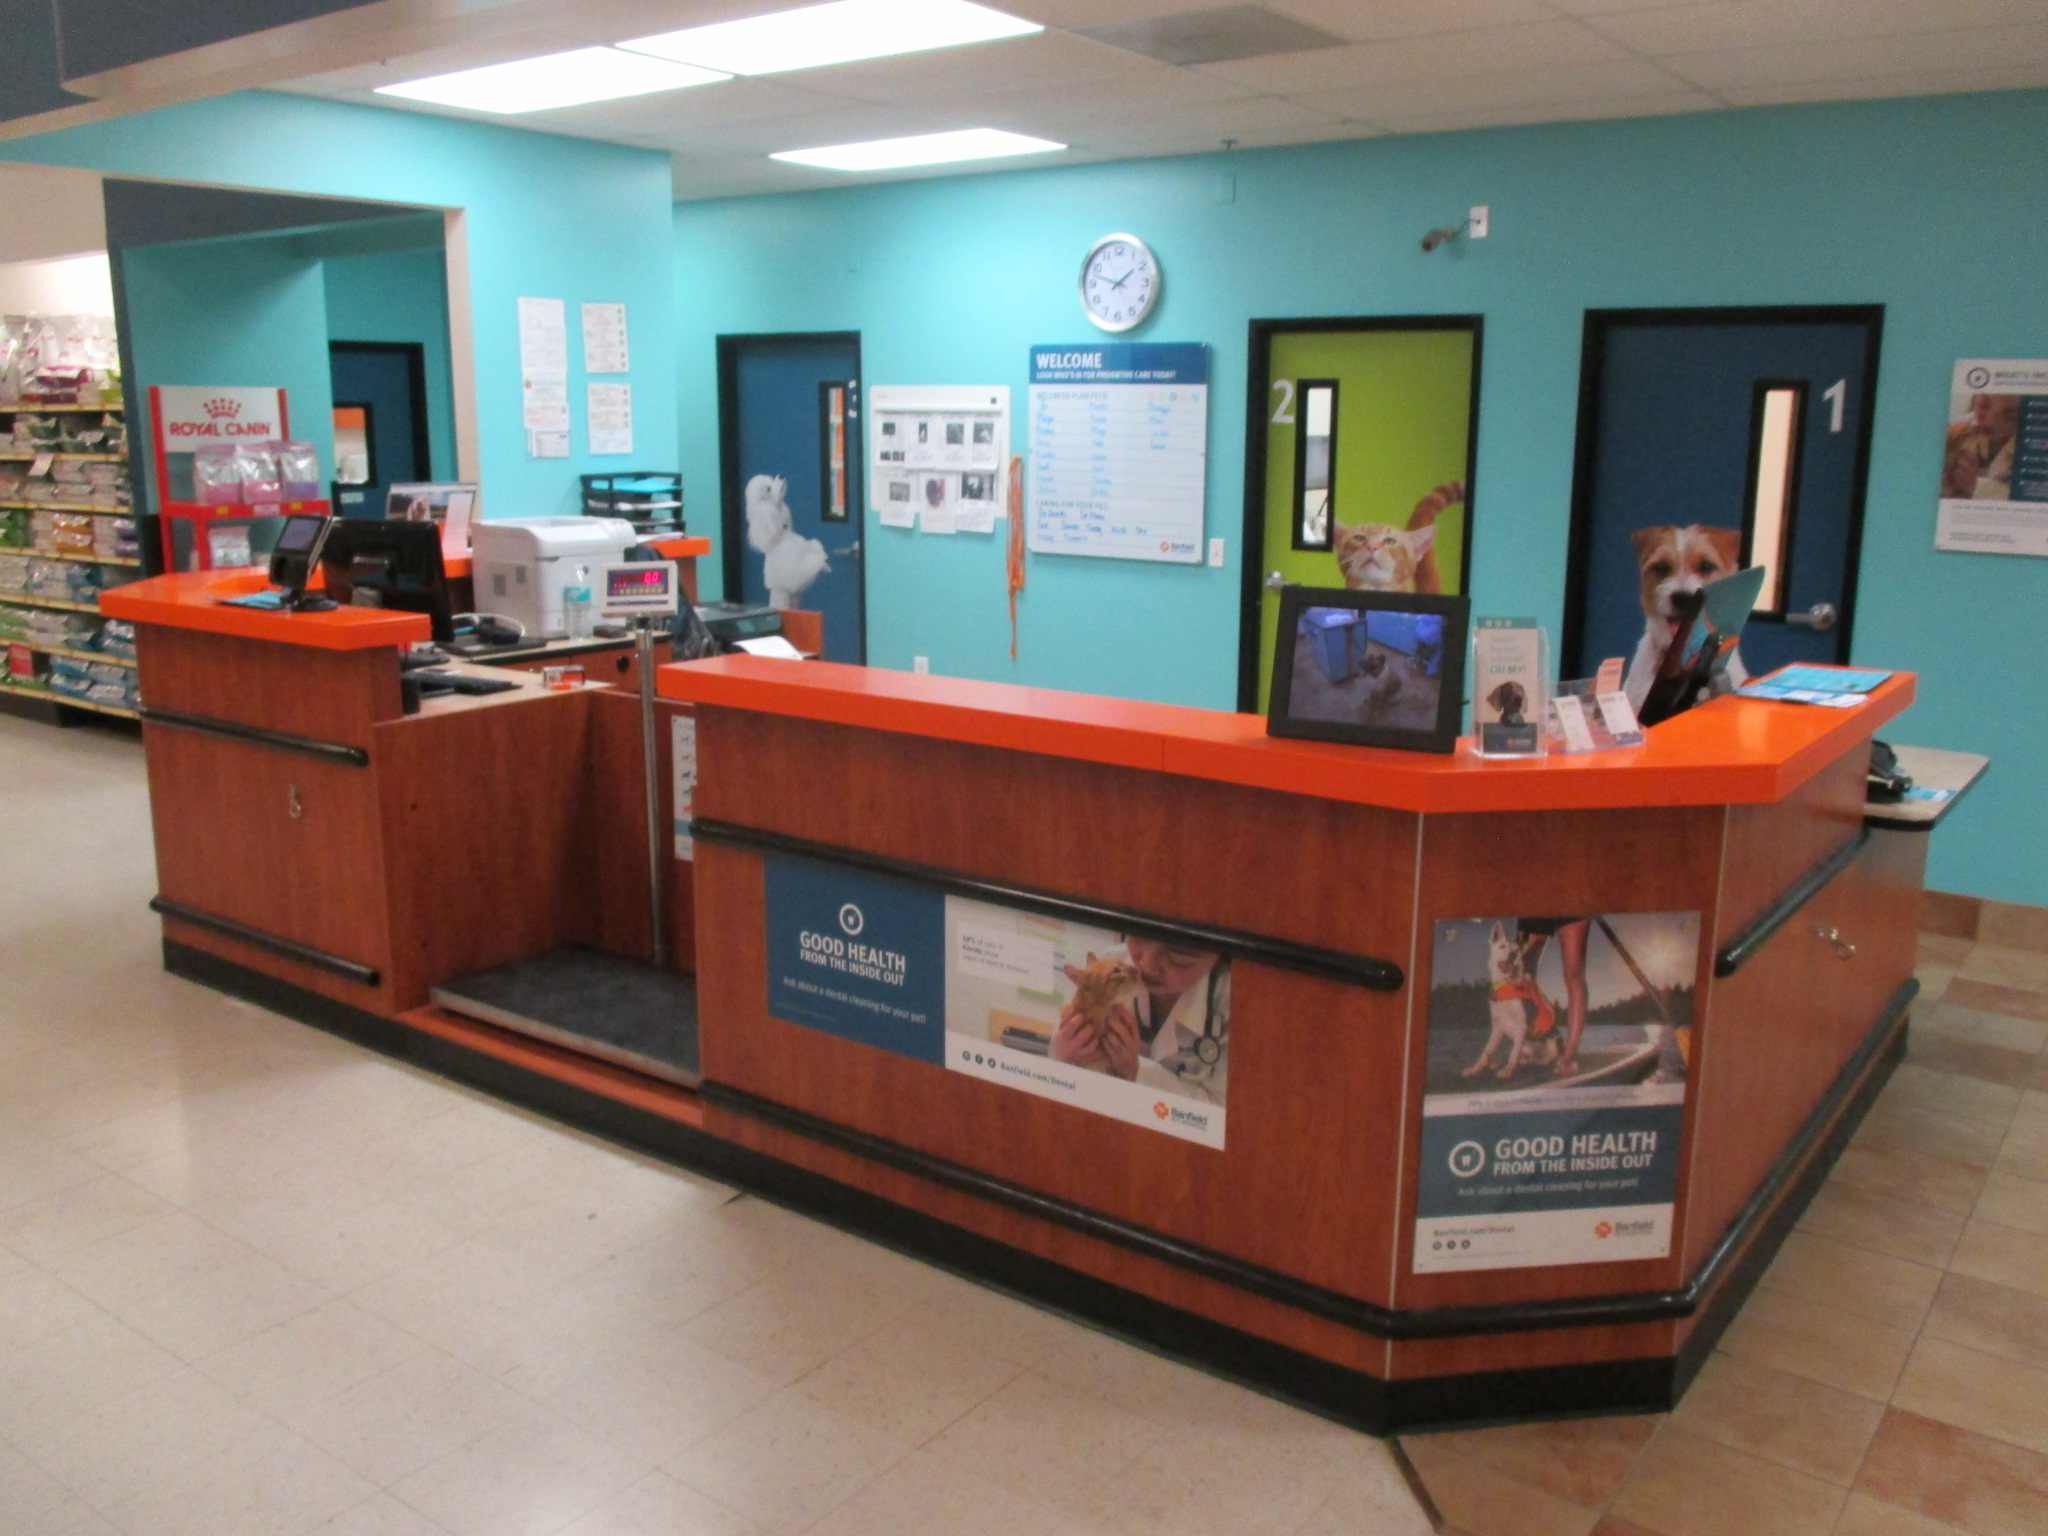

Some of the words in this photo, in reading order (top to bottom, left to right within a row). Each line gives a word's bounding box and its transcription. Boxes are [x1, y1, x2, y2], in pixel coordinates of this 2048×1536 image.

[1036, 352, 1102, 369] WELCOME
[1271, 379, 1295, 424] 2
[1821, 379, 1846, 433] 1
[170, 422, 220, 437] ROYAL
[225, 422, 270, 437] CANIN
[800, 930, 844, 957] GOOD
[848, 942, 906, 973] HEALTH
[800, 950, 827, 967] FROM
[830, 956, 847, 971] THE
[849, 961, 881, 981] INSIDE
[883, 971, 905, 987] OUT
[880, 1001, 892, 1014] for
[1495, 1136, 1564, 1159] GOOD
[1571, 1131, 1658, 1155] HEALTH
[1493, 1159, 1536, 1176] FROM
[1540, 1158, 1566, 1173] THE
[1571, 1155, 1619, 1172] INSIDE
[1622, 1153, 1654, 1168] OUT
[1457, 1187, 1475, 1196] Ask
[1478, 1185, 1505, 1196] about
[1515, 1182, 1544, 1194] dental
[1584, 1178, 1597, 1189] for
